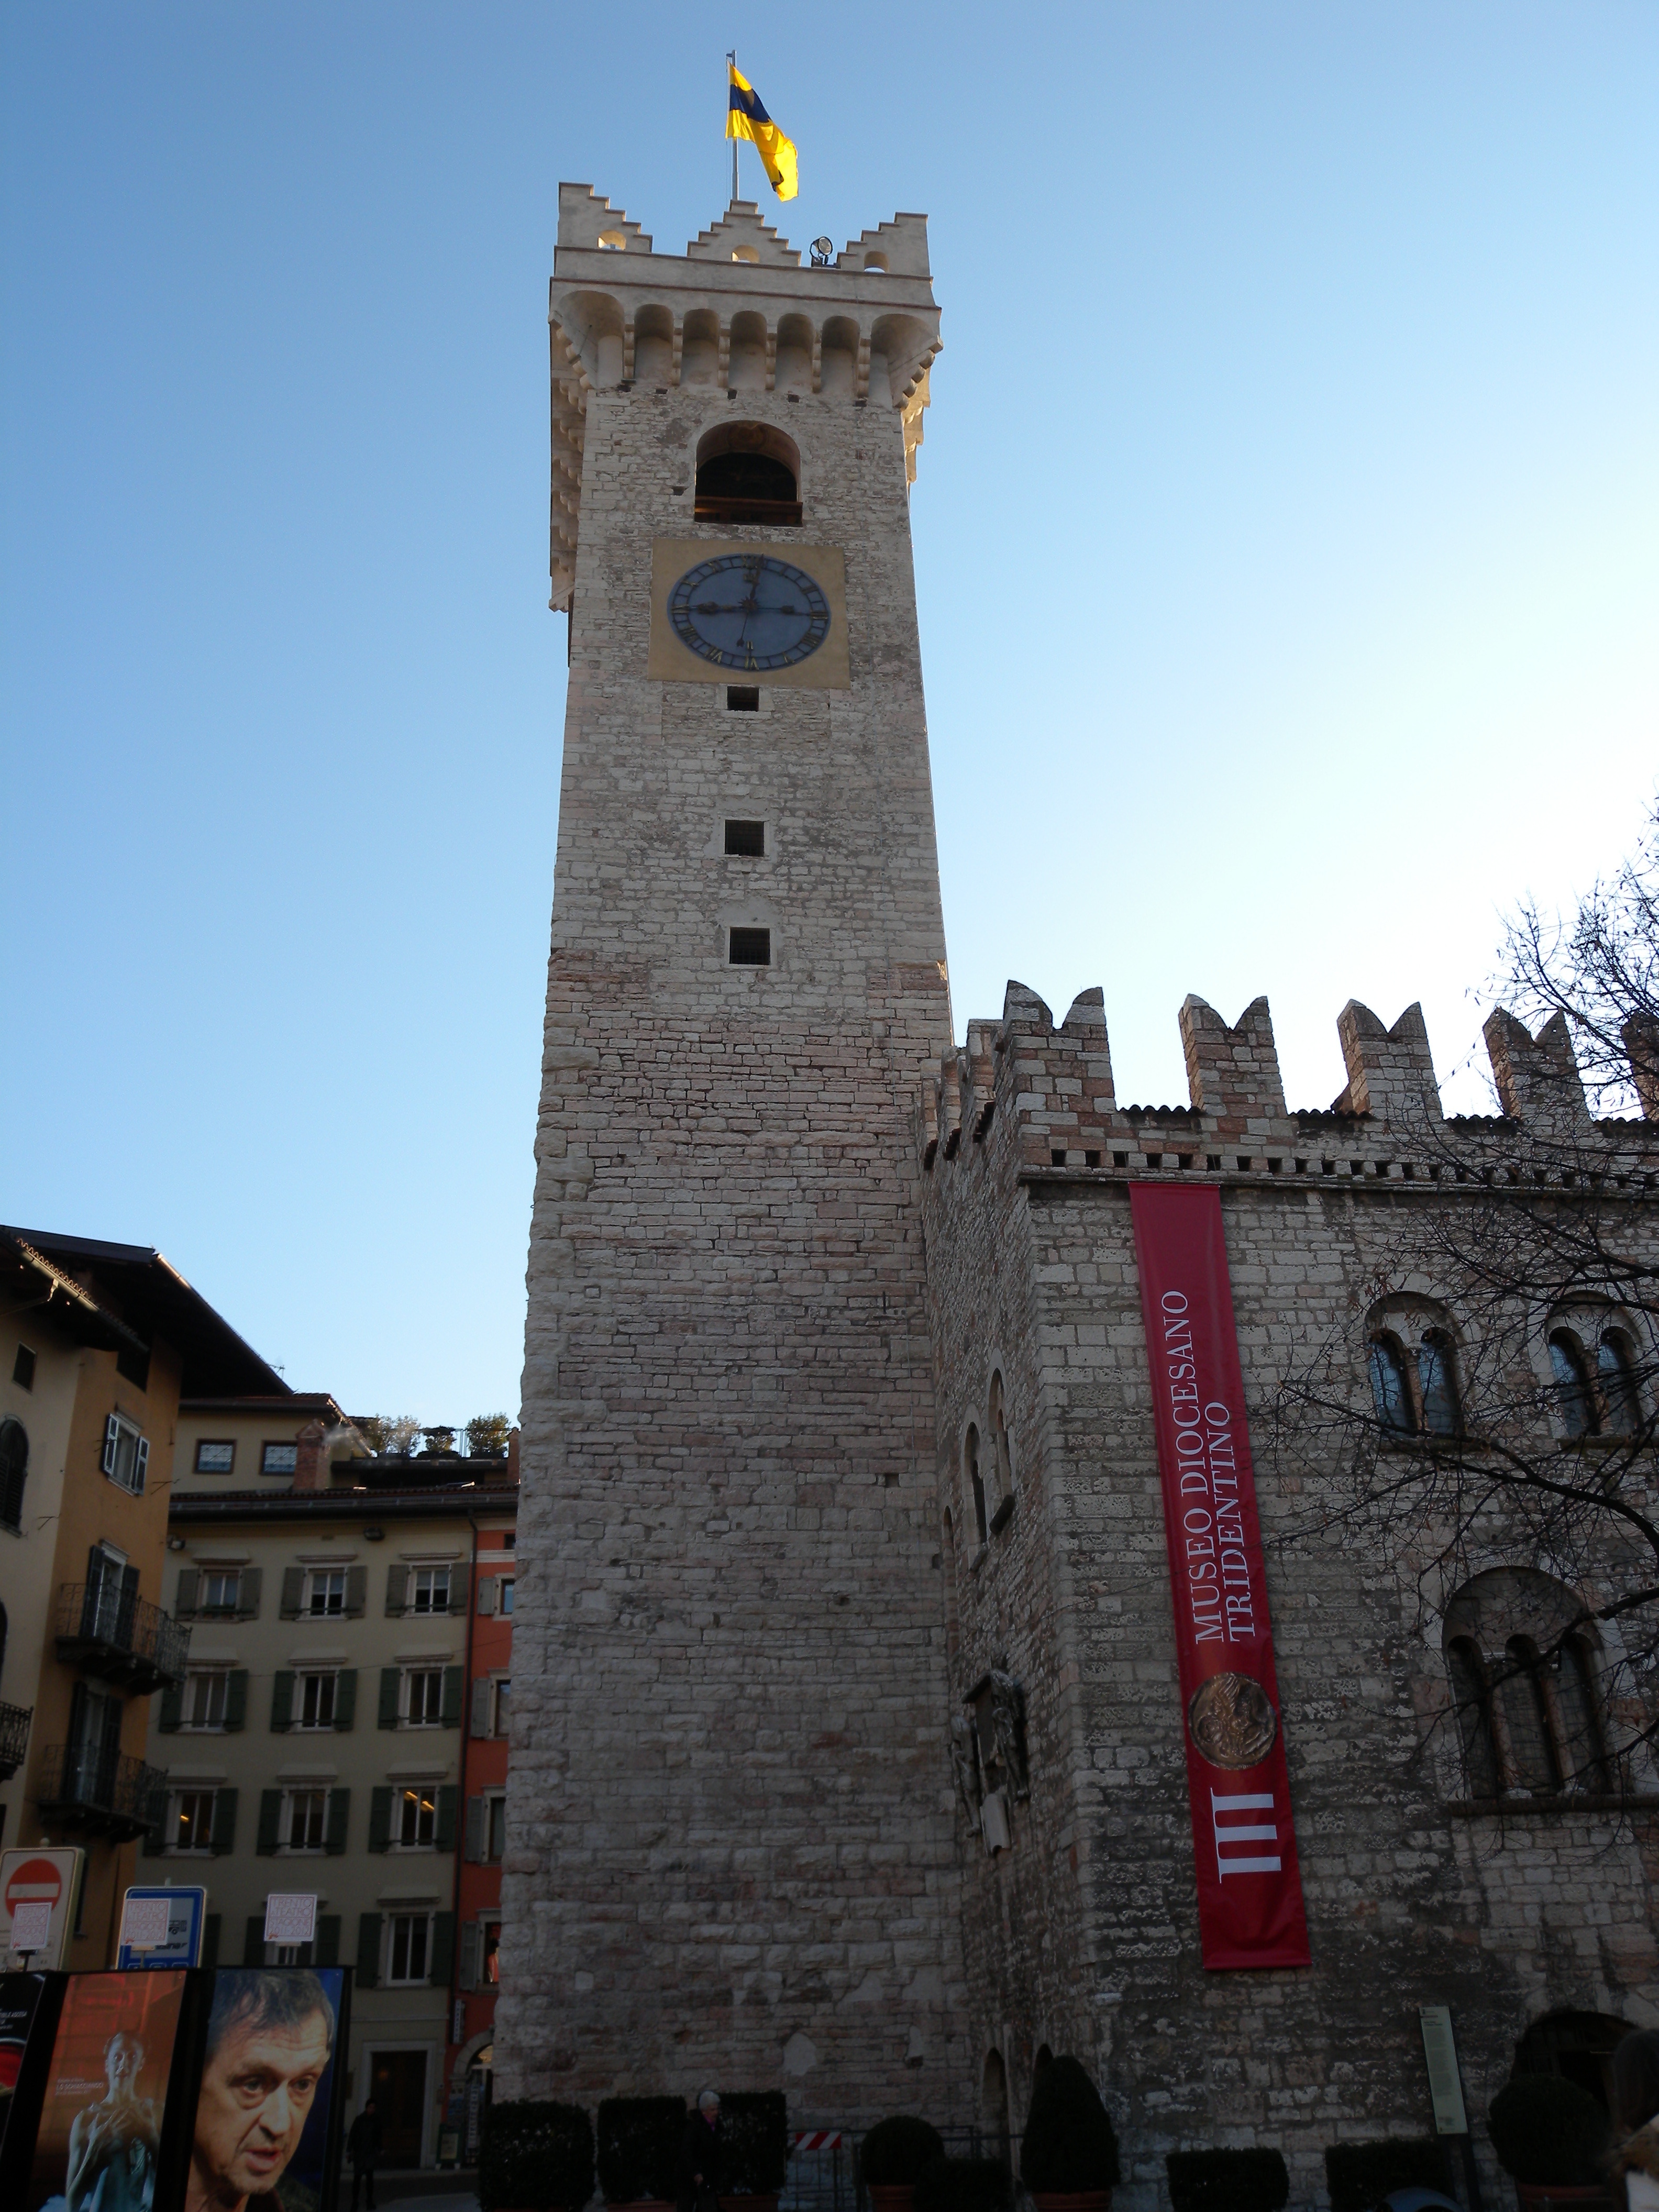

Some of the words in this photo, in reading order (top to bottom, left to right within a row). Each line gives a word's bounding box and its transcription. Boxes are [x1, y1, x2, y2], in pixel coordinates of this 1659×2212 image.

[1161, 1290, 1209, 1497] DIOCESANO
[1204, 1401, 1255, 1643] TRIDENTINO
[1184, 1508, 1224, 1644] MUSEO
[127, 1901, 167, 1911] TRENTO
[270, 1897, 313, 1907] TRENTO
[275, 1907, 313, 1916] TEATRO
